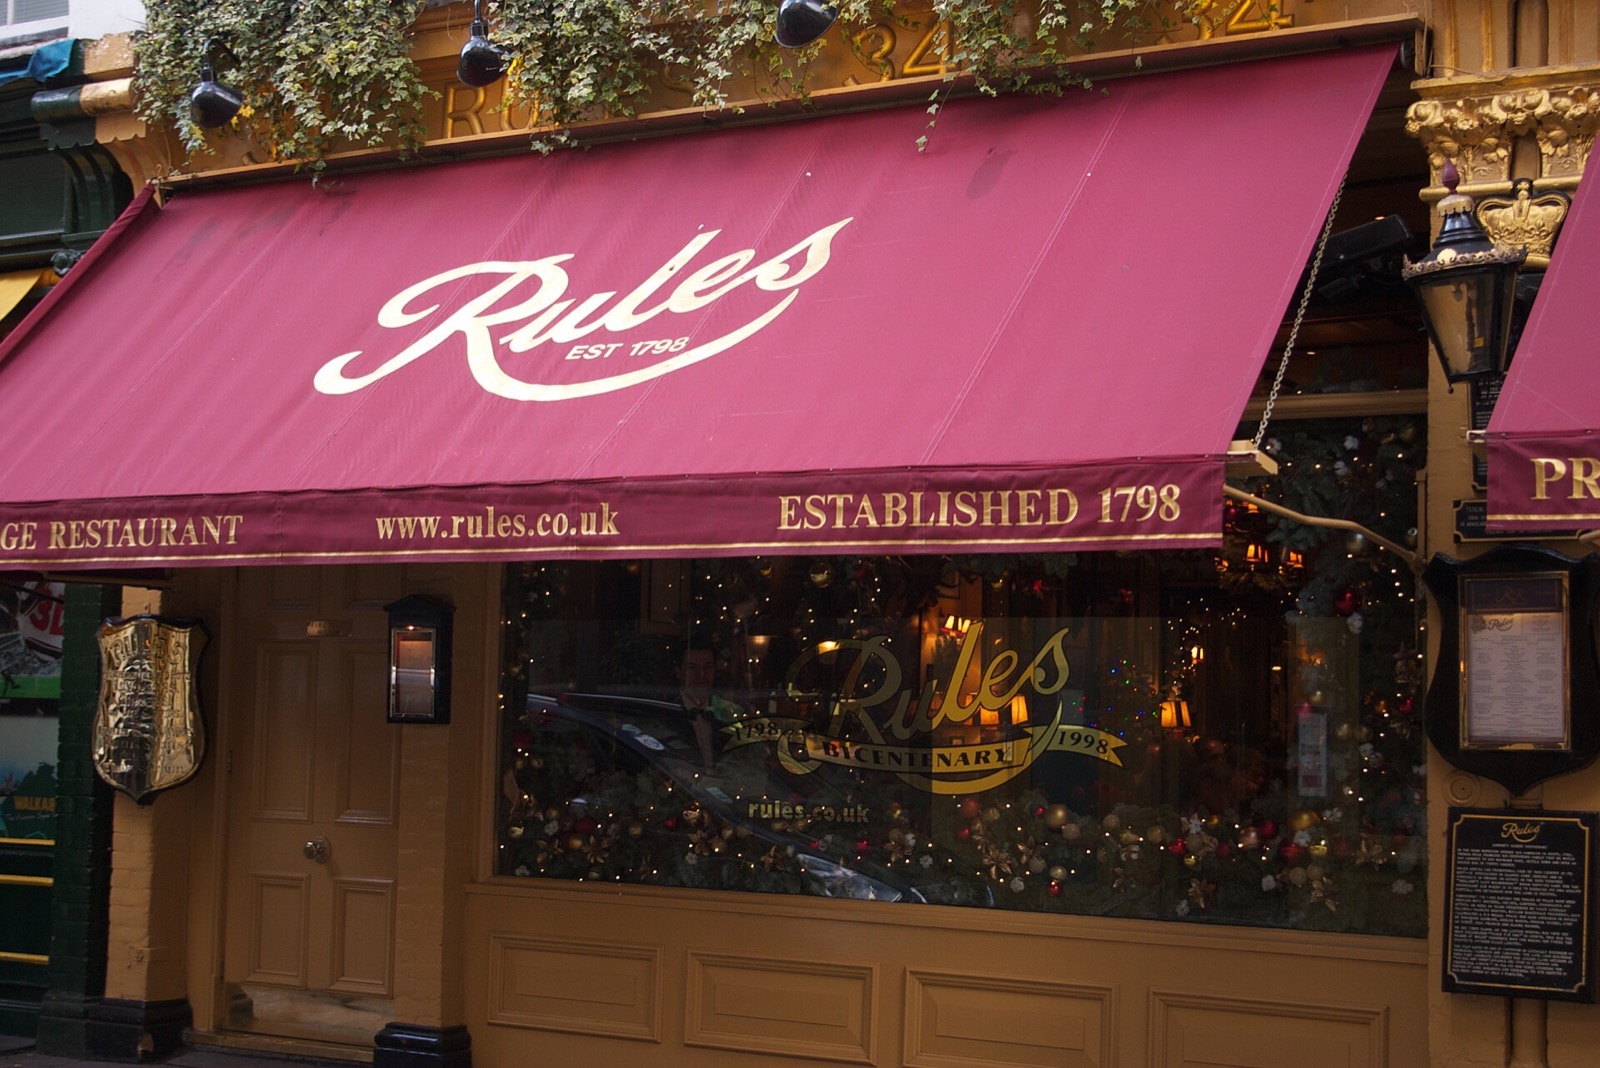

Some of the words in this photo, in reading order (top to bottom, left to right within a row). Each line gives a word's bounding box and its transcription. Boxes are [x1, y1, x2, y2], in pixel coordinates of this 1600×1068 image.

[313, 217, 854, 401] Rules
[565, 342, 624, 360] EST
[628, 335, 690, 357] 1798
[375, 503, 621, 541] www.rules.co.uk
[777, 488, 1079, 531] ESTABLISHED
[1097, 483, 1182, 524] 1798
[47, 514, 244, 550] RESTAURANT
[777, 620, 1071, 795] Rules
[733, 719, 780, 742] 1798
[1057, 728, 1110, 756] 1998
[822, 739, 1013, 769] BICENTENARY
[747, 799, 870, 824] rules.co.uk
[1500, 822, 1542, 843] Rules
